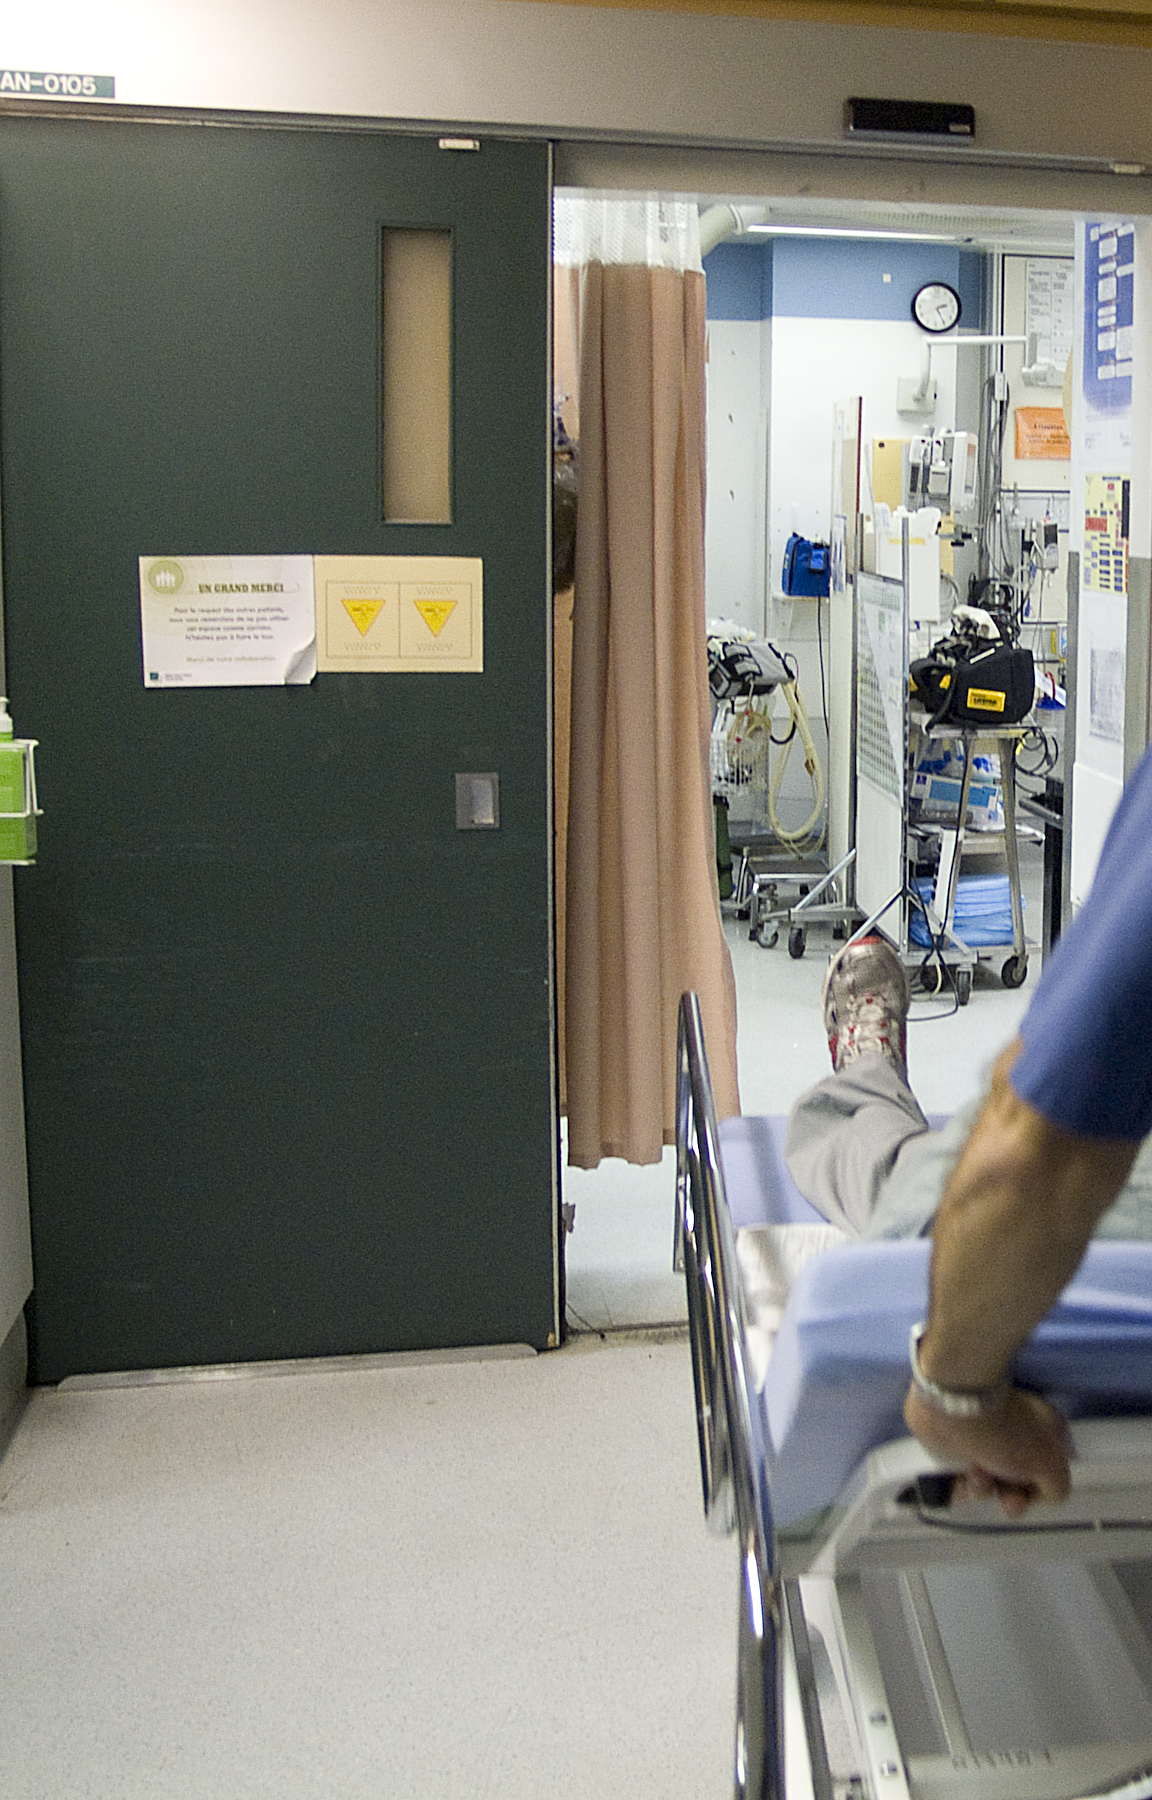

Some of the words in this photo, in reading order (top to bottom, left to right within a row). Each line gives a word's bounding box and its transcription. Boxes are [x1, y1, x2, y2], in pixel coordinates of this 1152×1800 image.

[0, 71, 97, 95] AN-0105
[198, 583, 212, 594] UN
[214, 583, 249, 594] GRAND
[251, 582, 285, 593] MERCI
